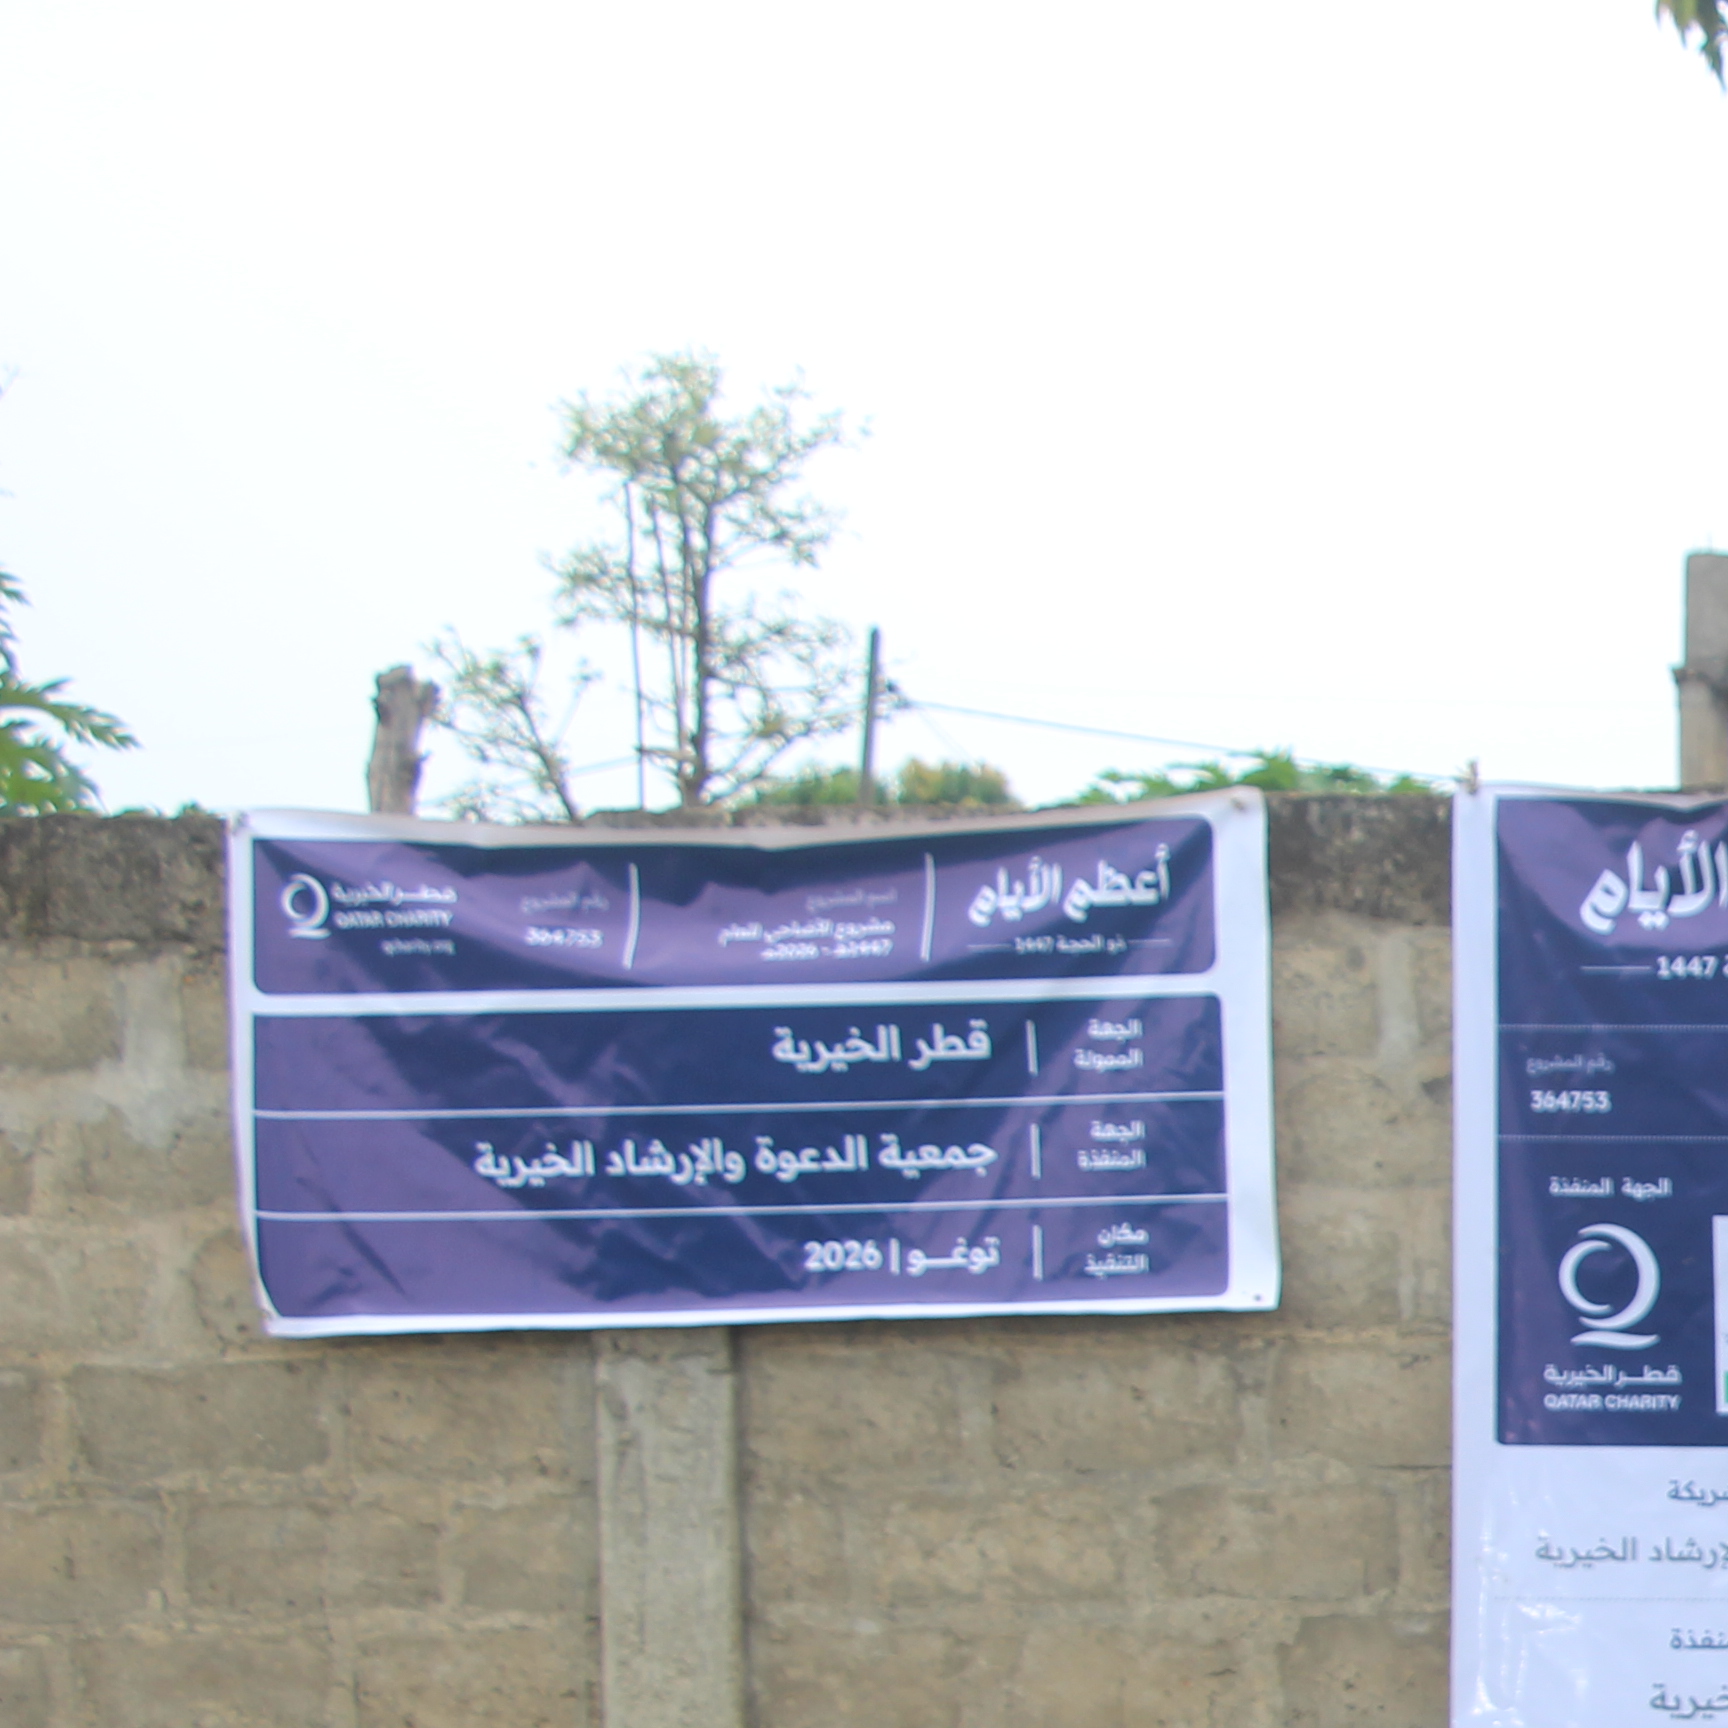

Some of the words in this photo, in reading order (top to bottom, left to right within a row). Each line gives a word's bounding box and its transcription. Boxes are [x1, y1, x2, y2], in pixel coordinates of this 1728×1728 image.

[968, 855, 1062, 927] الأيام
[1063, 843, 1170, 923] أعظم
[1656, 956, 1717, 980] 1447
[908, 1019, 992, 1070] قطر
[1087, 1018, 1143, 1042] الجهة
[771, 1025, 900, 1072] الخيرية
[1530, 1089, 1612, 1113] 364753
[1089, 1120, 1146, 1144] الجهة
[473, 1140, 595, 1188] الخيرية
[605, 1137, 746, 1186] والإرشاد
[753, 1135, 869, 1182] الدعوة
[877, 1133, 999, 1178] جمعية
[1548, 1177, 1614, 1197] المنفذة
[1621, 1177, 1673, 1200] الجهة
[1096, 1222, 1149, 1248] مكان
[803, 1240, 883, 1273] 2026
[1083, 1253, 1150, 1280] التنفيذ
[1543, 1363, 1617, 1389] الخيرية
[1543, 1393, 1603, 1411] QATAR
[1604, 1393, 1682, 1411] CHARITY
[1535, 1536, 1636, 1569] الخيرية
